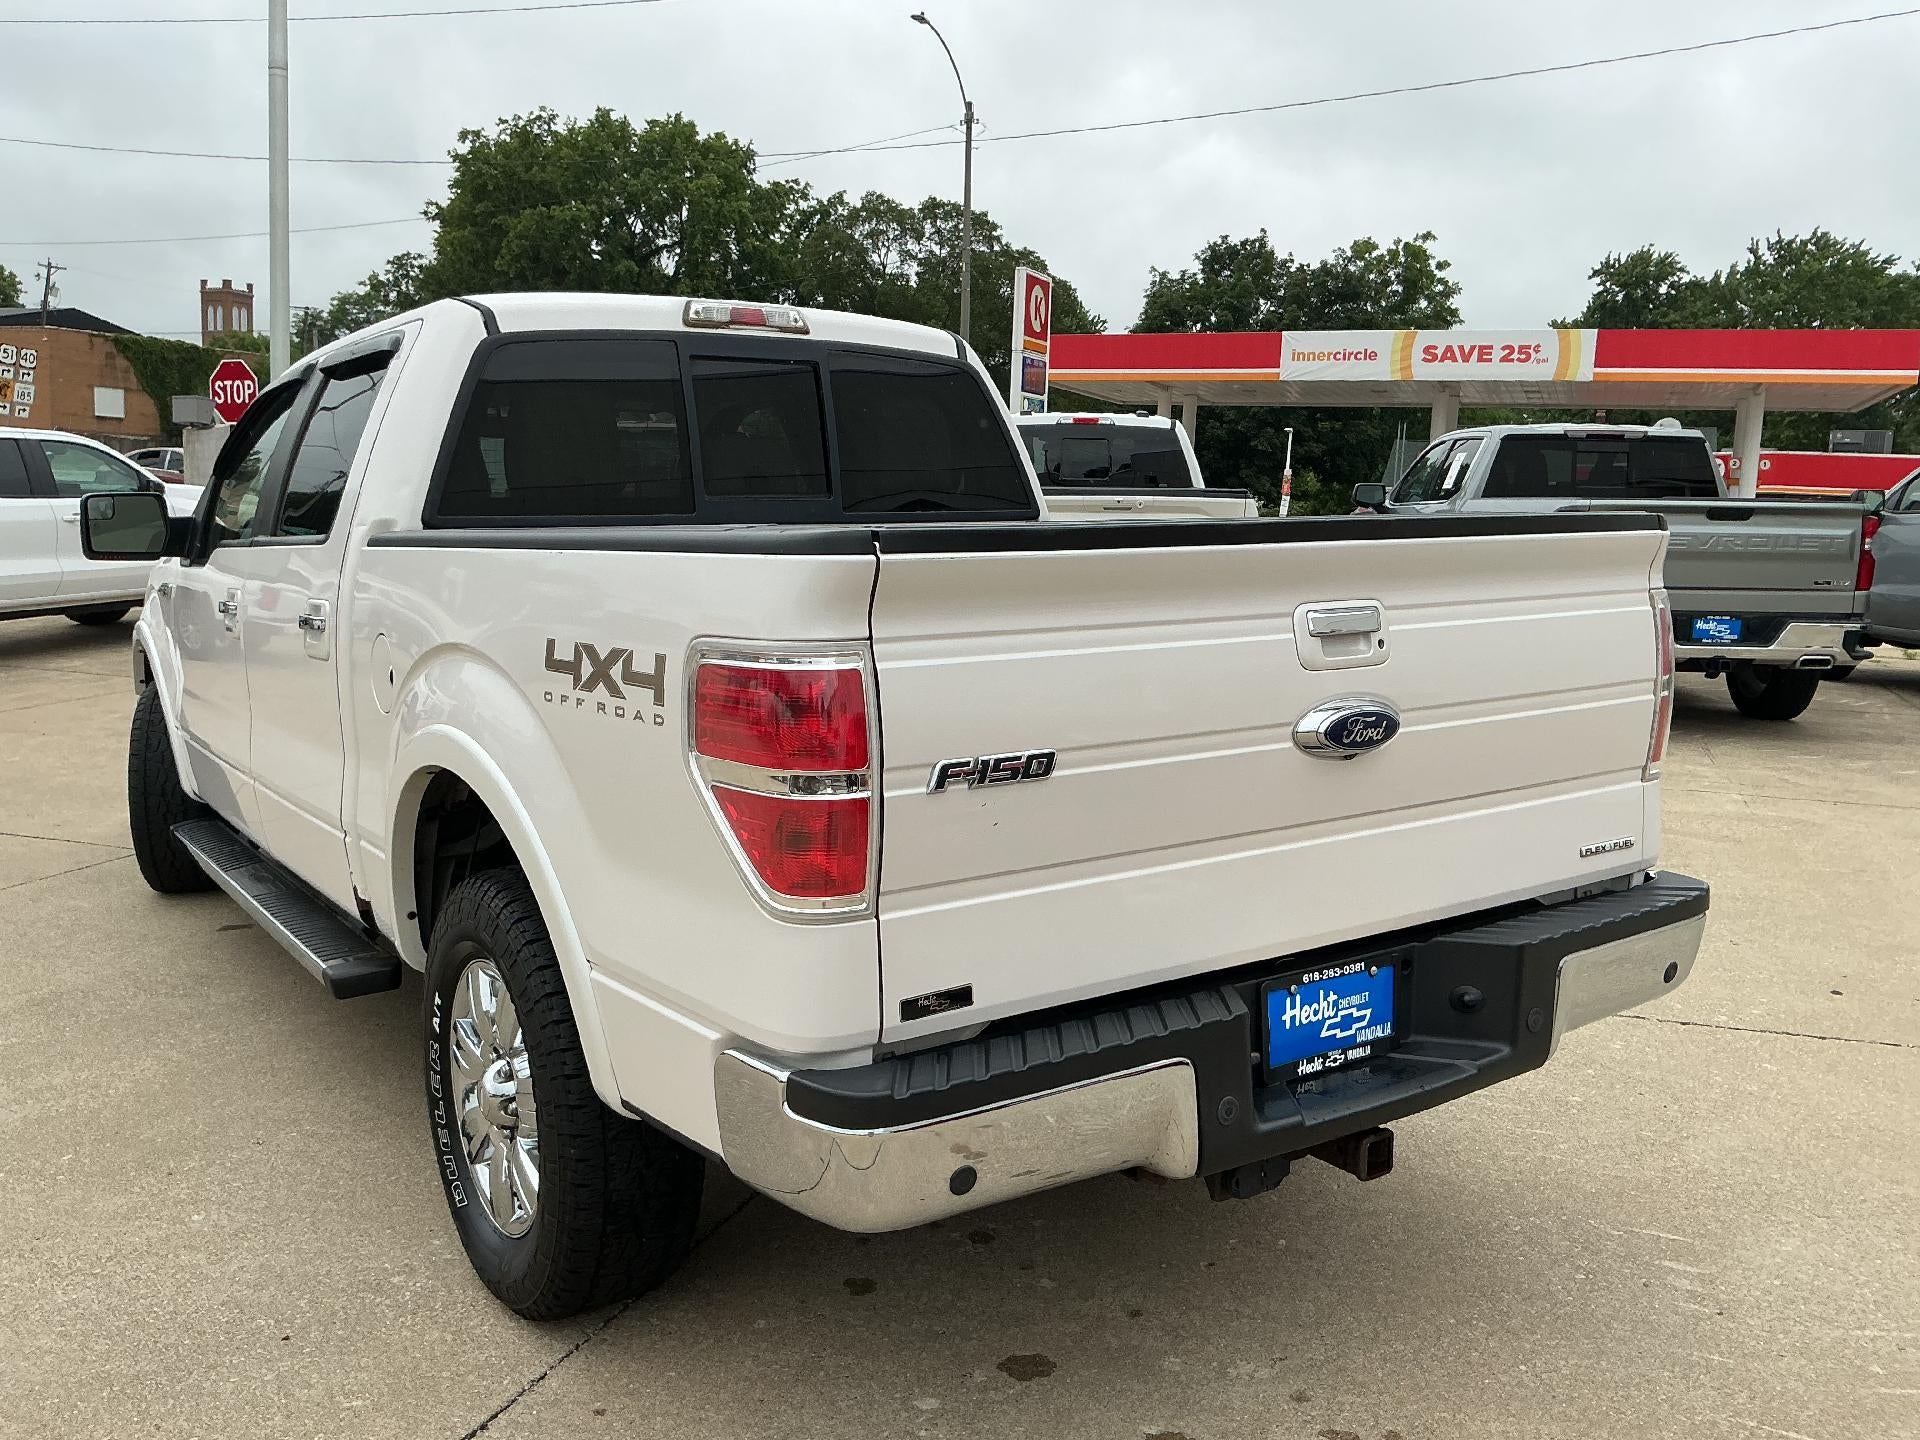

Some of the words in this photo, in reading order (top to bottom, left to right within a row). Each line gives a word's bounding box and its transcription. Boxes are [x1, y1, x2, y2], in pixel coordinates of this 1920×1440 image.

[2, 348, 14, 361] 51
[21, 352, 36, 364] 40
[1291, 348, 1378, 362] innercircle
[1421, 344, 1493, 363] SAVE
[17, 390, 32, 401] 185
[214, 380, 254, 404] STOP
[543, 690, 586, 709] OFF
[596, 701, 665, 727] ROAD
[1342, 716, 1388, 744] Ford
[1584, 844, 1607, 856] FLEX
[1612, 838, 1635, 850] FUEL
[1302, 961, 1366, 984] 618-283-0381
[1281, 989, 1339, 1030] Hecht
[1338, 991, 1370, 1010] CHEVROLET
[431, 991, 442, 1034] A/T
[1356, 1021, 1392, 1043] VANDALIA
[1297, 1056, 1325, 1077] Hecht
[1346, 1044, 1371, 1061] VANDALIA
[429, 1040, 468, 1208] DUELER
